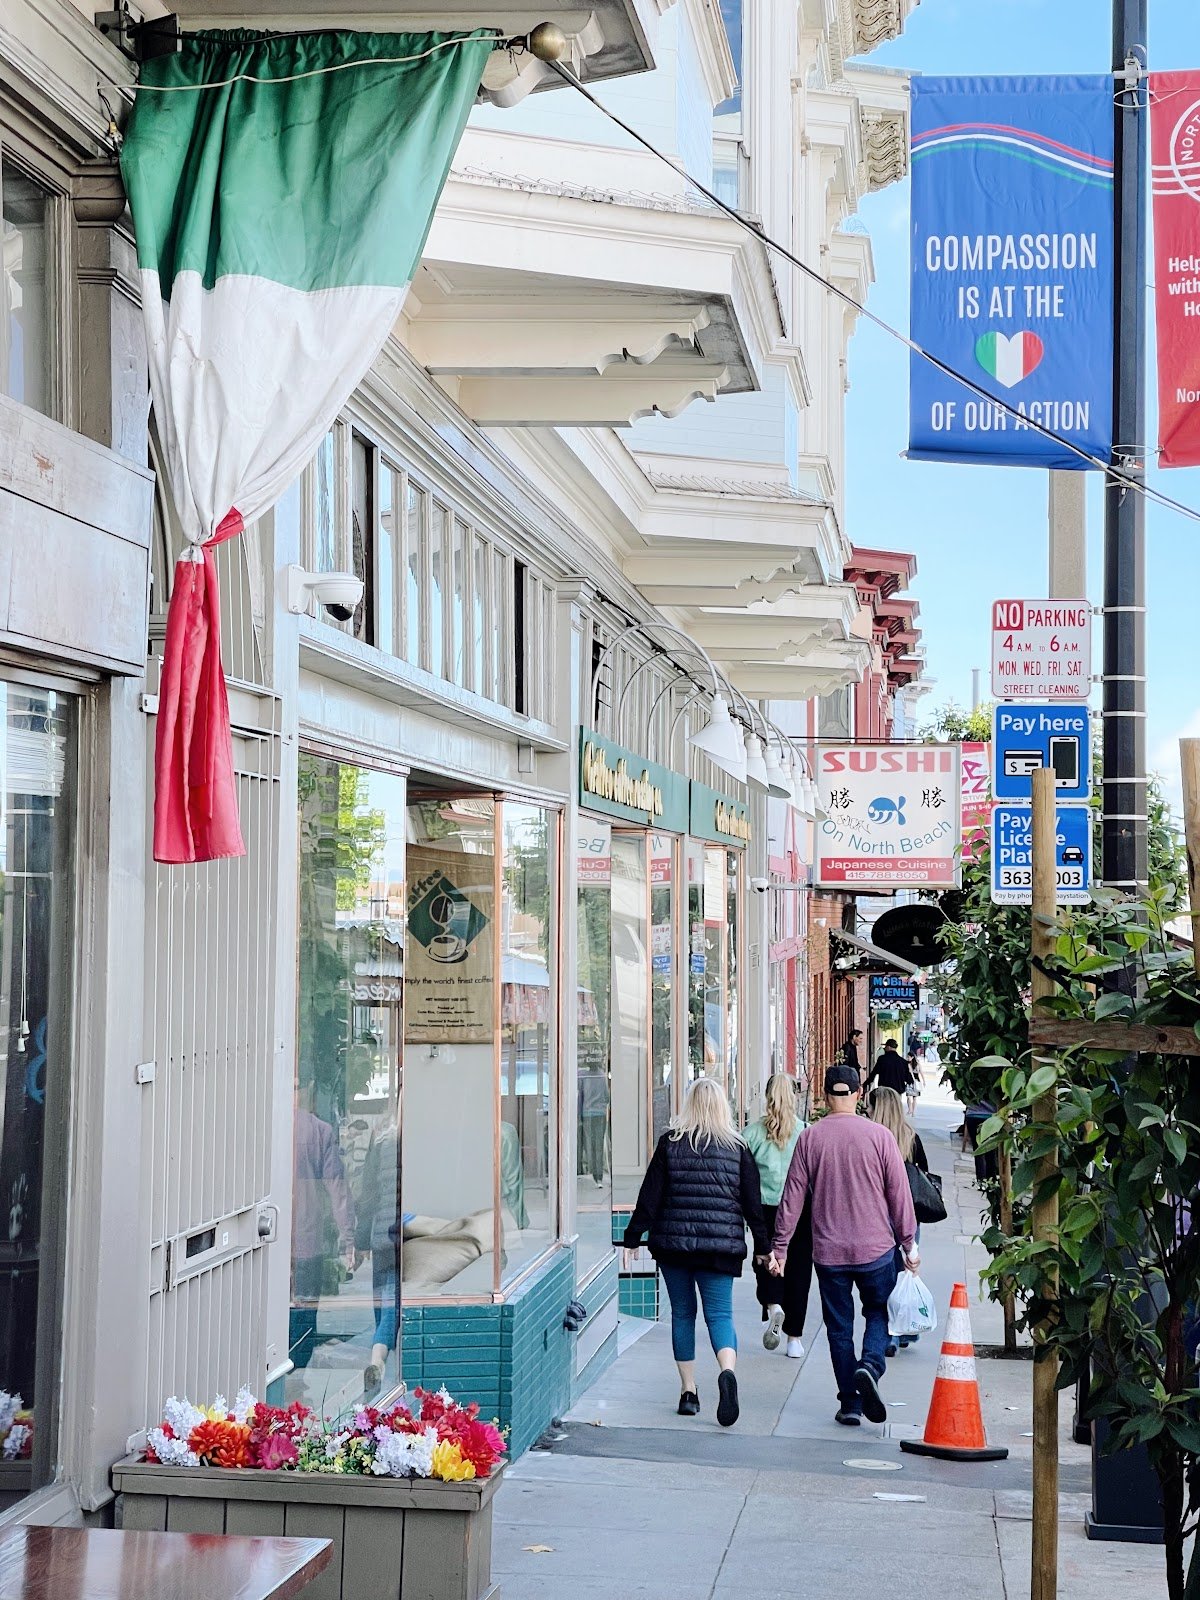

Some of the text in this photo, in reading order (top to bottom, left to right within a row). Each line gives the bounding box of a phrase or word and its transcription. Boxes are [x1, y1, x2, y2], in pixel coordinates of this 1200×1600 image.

[926, 232, 1097, 271] COMPASSION
[1168, 254, 1200, 274] Hel
[958, 285, 1065, 319] IS AT THE
[931, 401, 1090, 431] OF OUR ACTION
[996, 603, 1086, 627] NO PARKING
[1002, 634, 1014, 652] 4
[1016, 643, 1034, 652] A.M.
[1050, 634, 1060, 652] 6
[1063, 643, 1081, 652] A.M.
[998, 660, 1085, 676] MON. WED. FRI. SAT.
[1003, 684, 1080, 694] STREET CLEANING
[1000, 713, 1084, 736] Pay here
[822, 751, 952, 773] SUSHI
[1000, 812, 1032, 832] Pay
[822, 819, 844, 842] On
[847, 834, 895, 855] North
[900, 819, 952, 853] Beach
[1000, 830, 1066, 846] Licee
[826, 860, 947, 870] Japanese Cuisine
[1000, 847, 1032, 864] Plat
[1007, 892, 1016, 900] by
[1017, 892, 1032, 900] phon
[405, 976, 420, 986] imply
[422, 976, 432, 984] the
[873, 987, 916, 997] AVENUE
